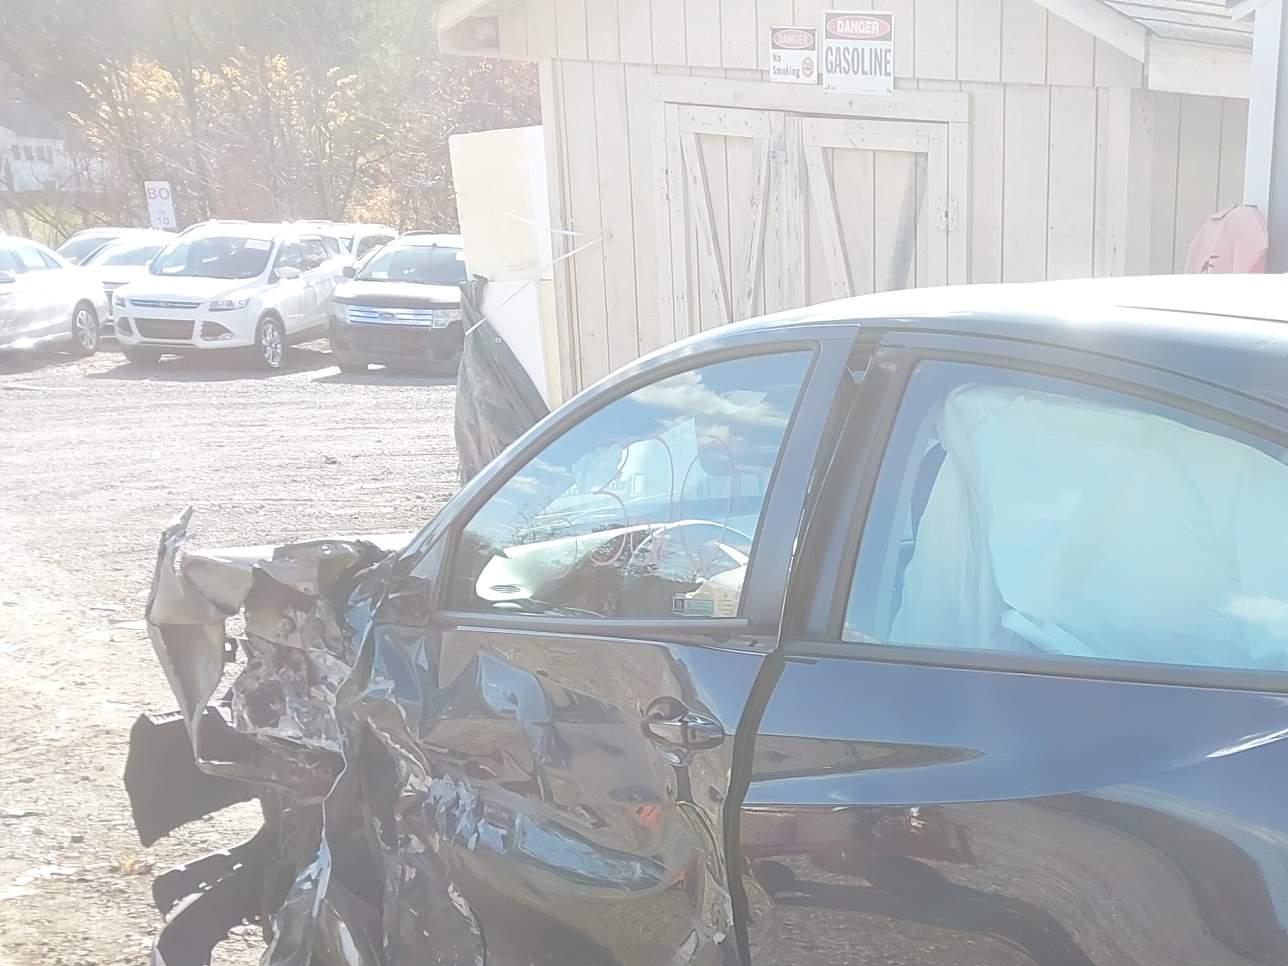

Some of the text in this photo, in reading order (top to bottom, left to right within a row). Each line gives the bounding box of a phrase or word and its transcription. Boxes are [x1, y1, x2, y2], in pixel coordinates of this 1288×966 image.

[836, 19, 880, 35] DANGER
[778, 33, 809, 46] DANGER
[772, 53, 782, 63] No
[825, 46, 892, 76] GASOLINE
[772, 64, 800, 79] Smoking
